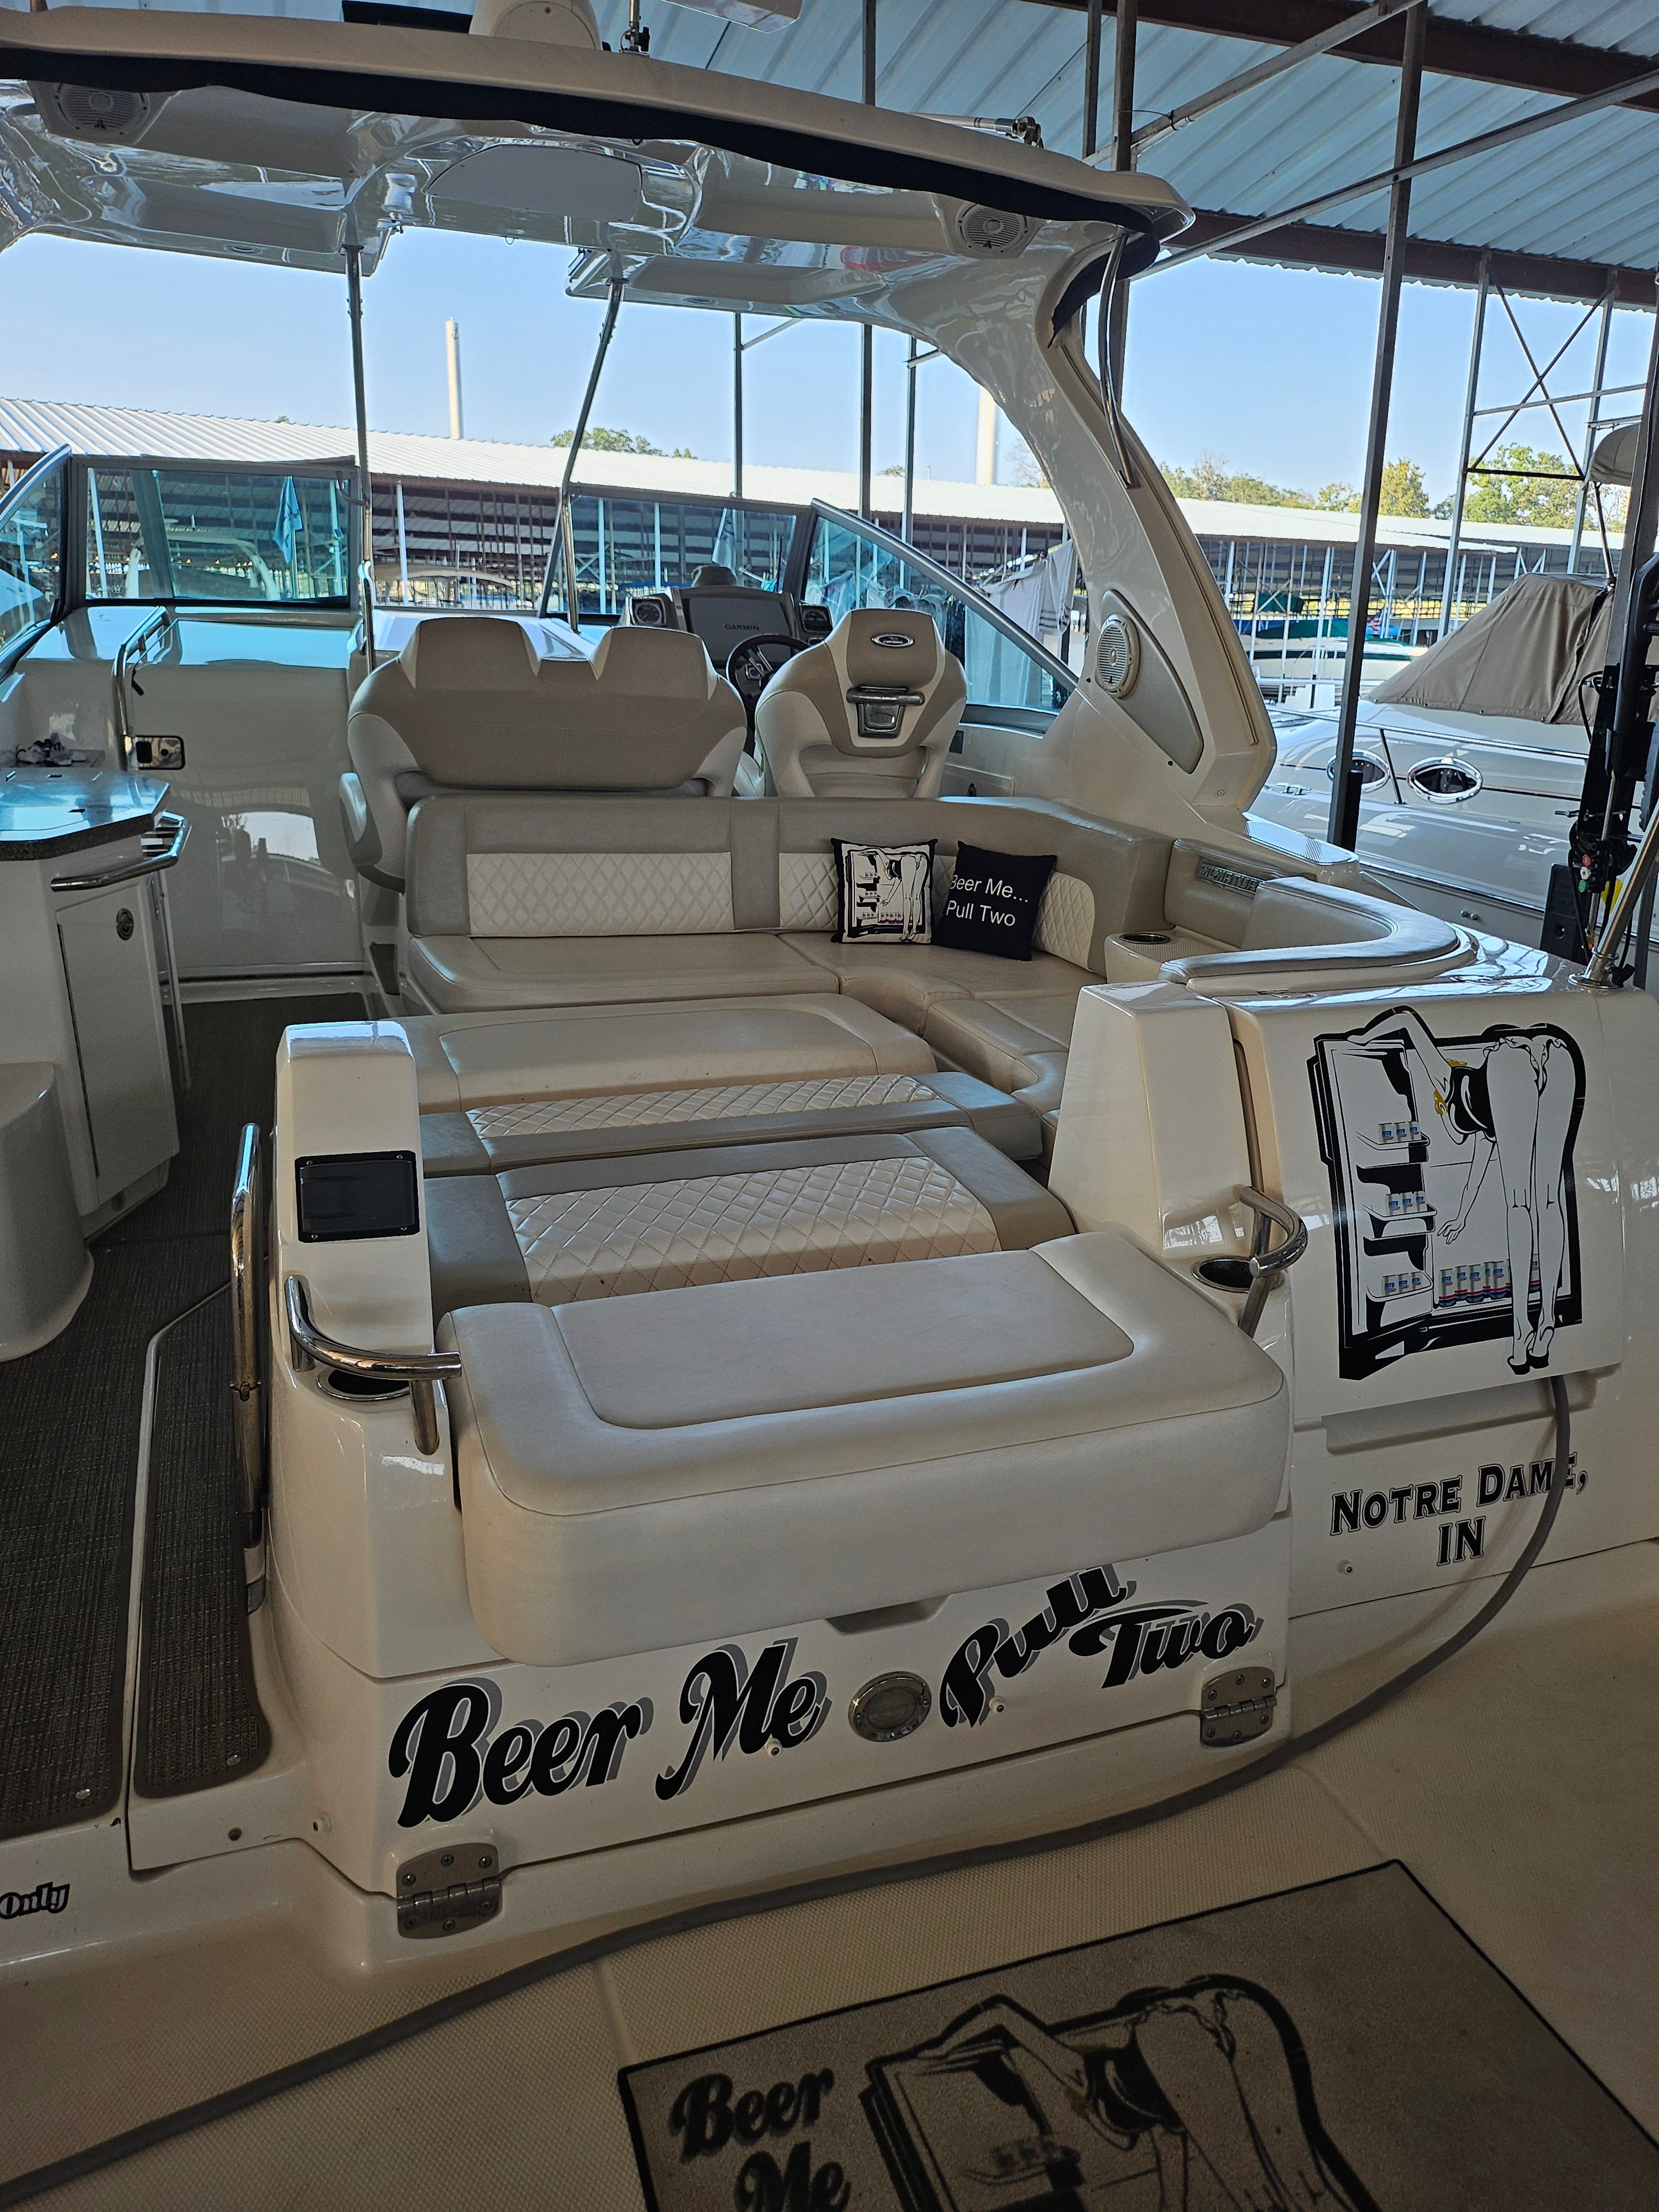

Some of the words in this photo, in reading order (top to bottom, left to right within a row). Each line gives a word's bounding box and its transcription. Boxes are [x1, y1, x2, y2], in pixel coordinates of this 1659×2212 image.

[950, 874, 982, 892] Beer
[985, 878, 1029, 902] Me...
[1200, 864, 1259, 893] SIGNATUR
[946, 900, 974, 920] Pull
[980, 905, 1016, 926] Two
[1330, 1474, 1463, 1536] NOTRE
[1437, 1516, 1485, 1566] IN
[939, 1563, 1137, 1728] Pull
[1068, 1599, 1264, 1689] Two
[388, 1677, 654, 1828] Beer
[655, 1637, 833, 1800] Me
[0, 1881, 70, 1919] Only
[670, 2067, 834, 2163] Beer
[734, 2141, 852, 2212] Me
